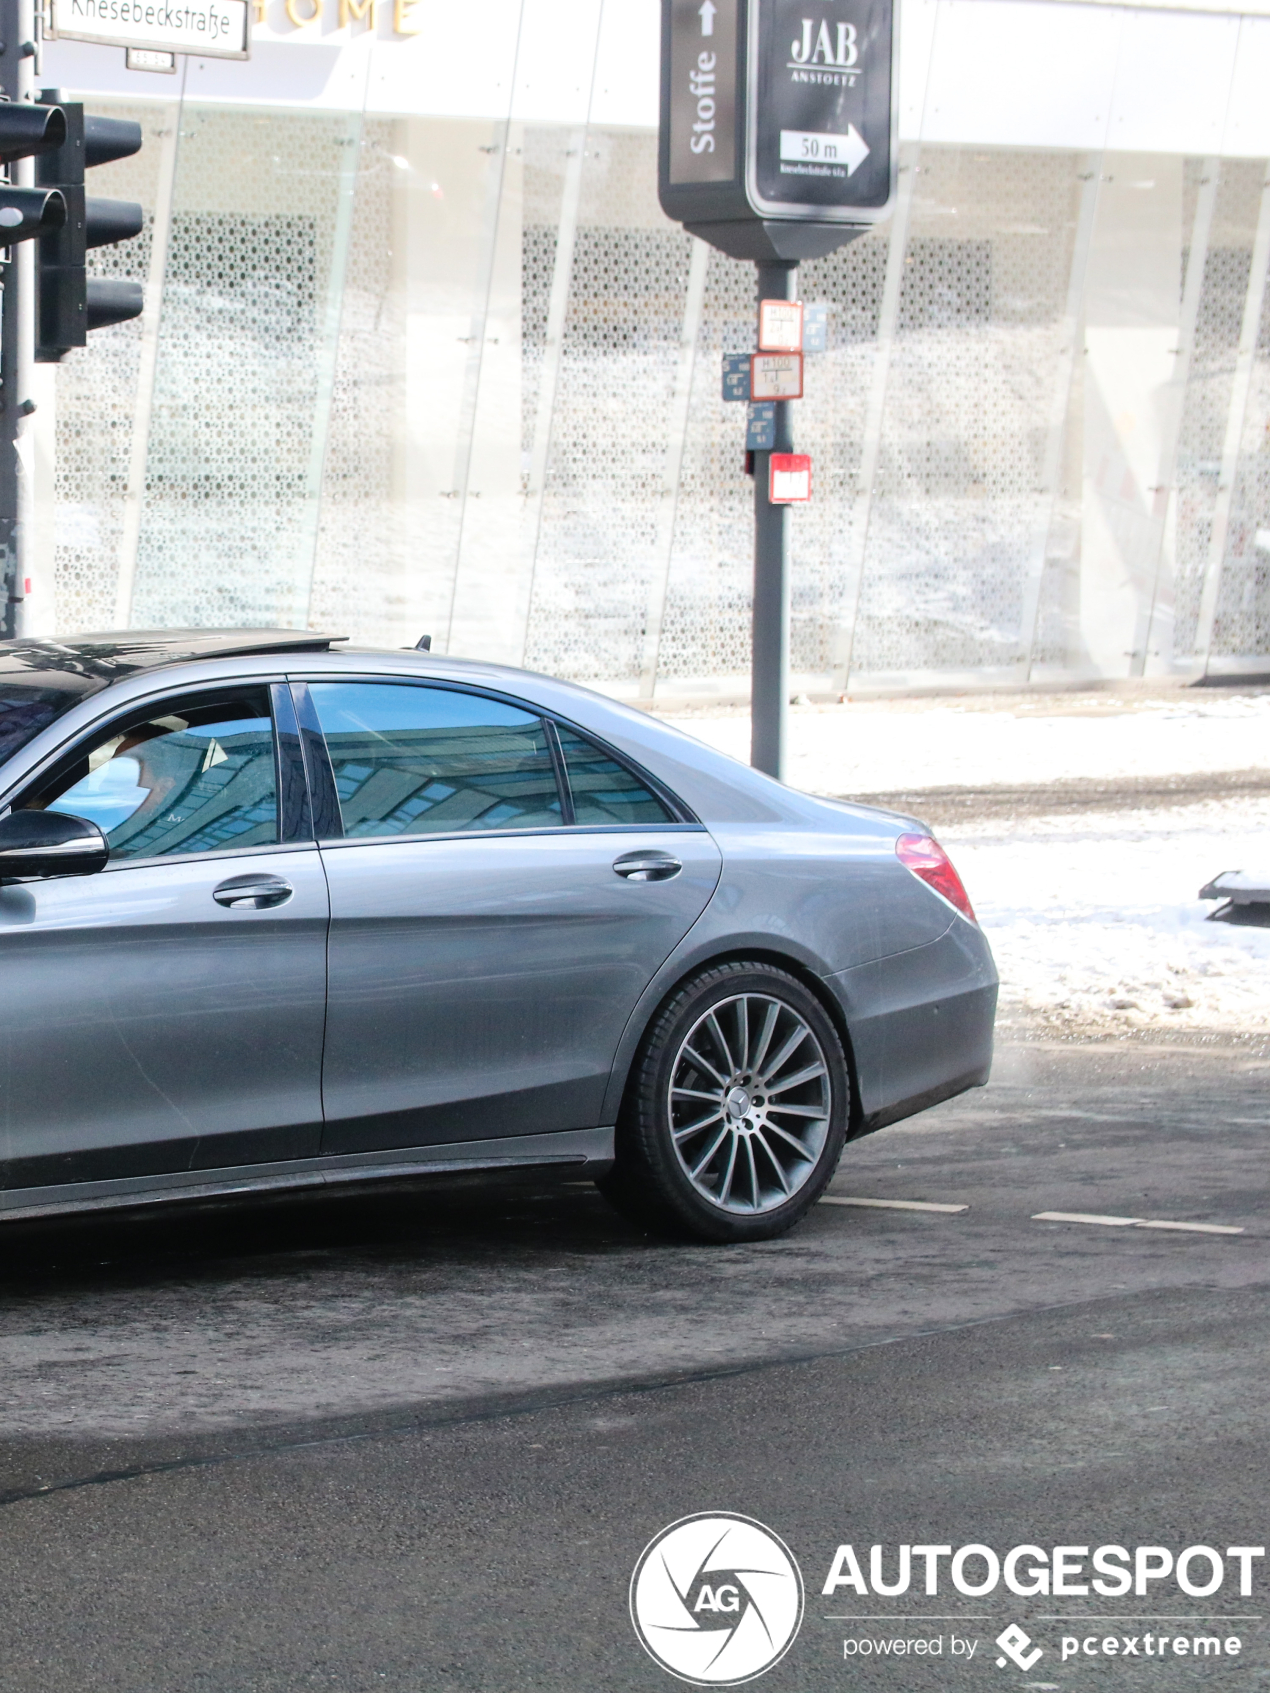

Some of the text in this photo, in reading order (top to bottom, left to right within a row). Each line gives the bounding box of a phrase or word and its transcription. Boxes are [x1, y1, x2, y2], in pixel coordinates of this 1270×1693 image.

[791, 18, 859, 67] JAB
[791, 70, 857, 87] ANSTOETZ
[690, 51, 717, 154] Stoffe
[802, 138, 838, 159] 50 m
